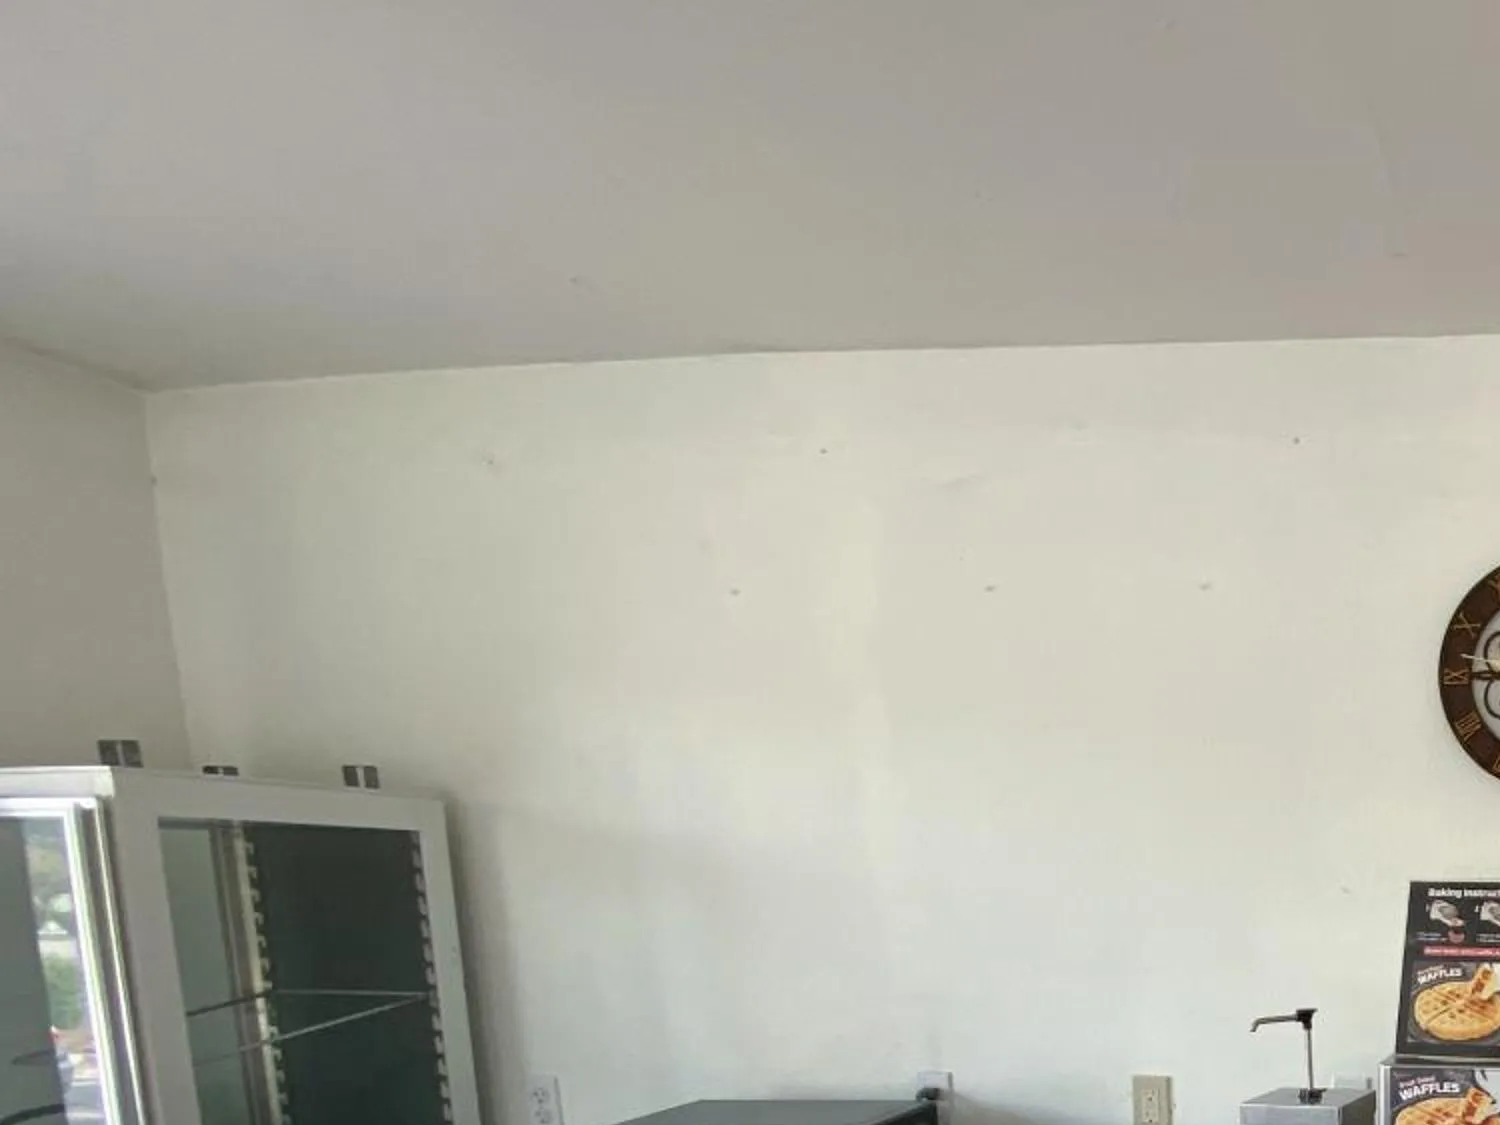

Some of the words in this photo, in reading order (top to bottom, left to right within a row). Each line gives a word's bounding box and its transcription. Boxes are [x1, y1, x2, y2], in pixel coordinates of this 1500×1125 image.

[1452, 612, 1481, 637] X
[1428, 888, 1462, 899] Baking
[1417, 968, 1462, 984] WAFFLES
[1399, 1082, 1460, 1100] WAFFLES
